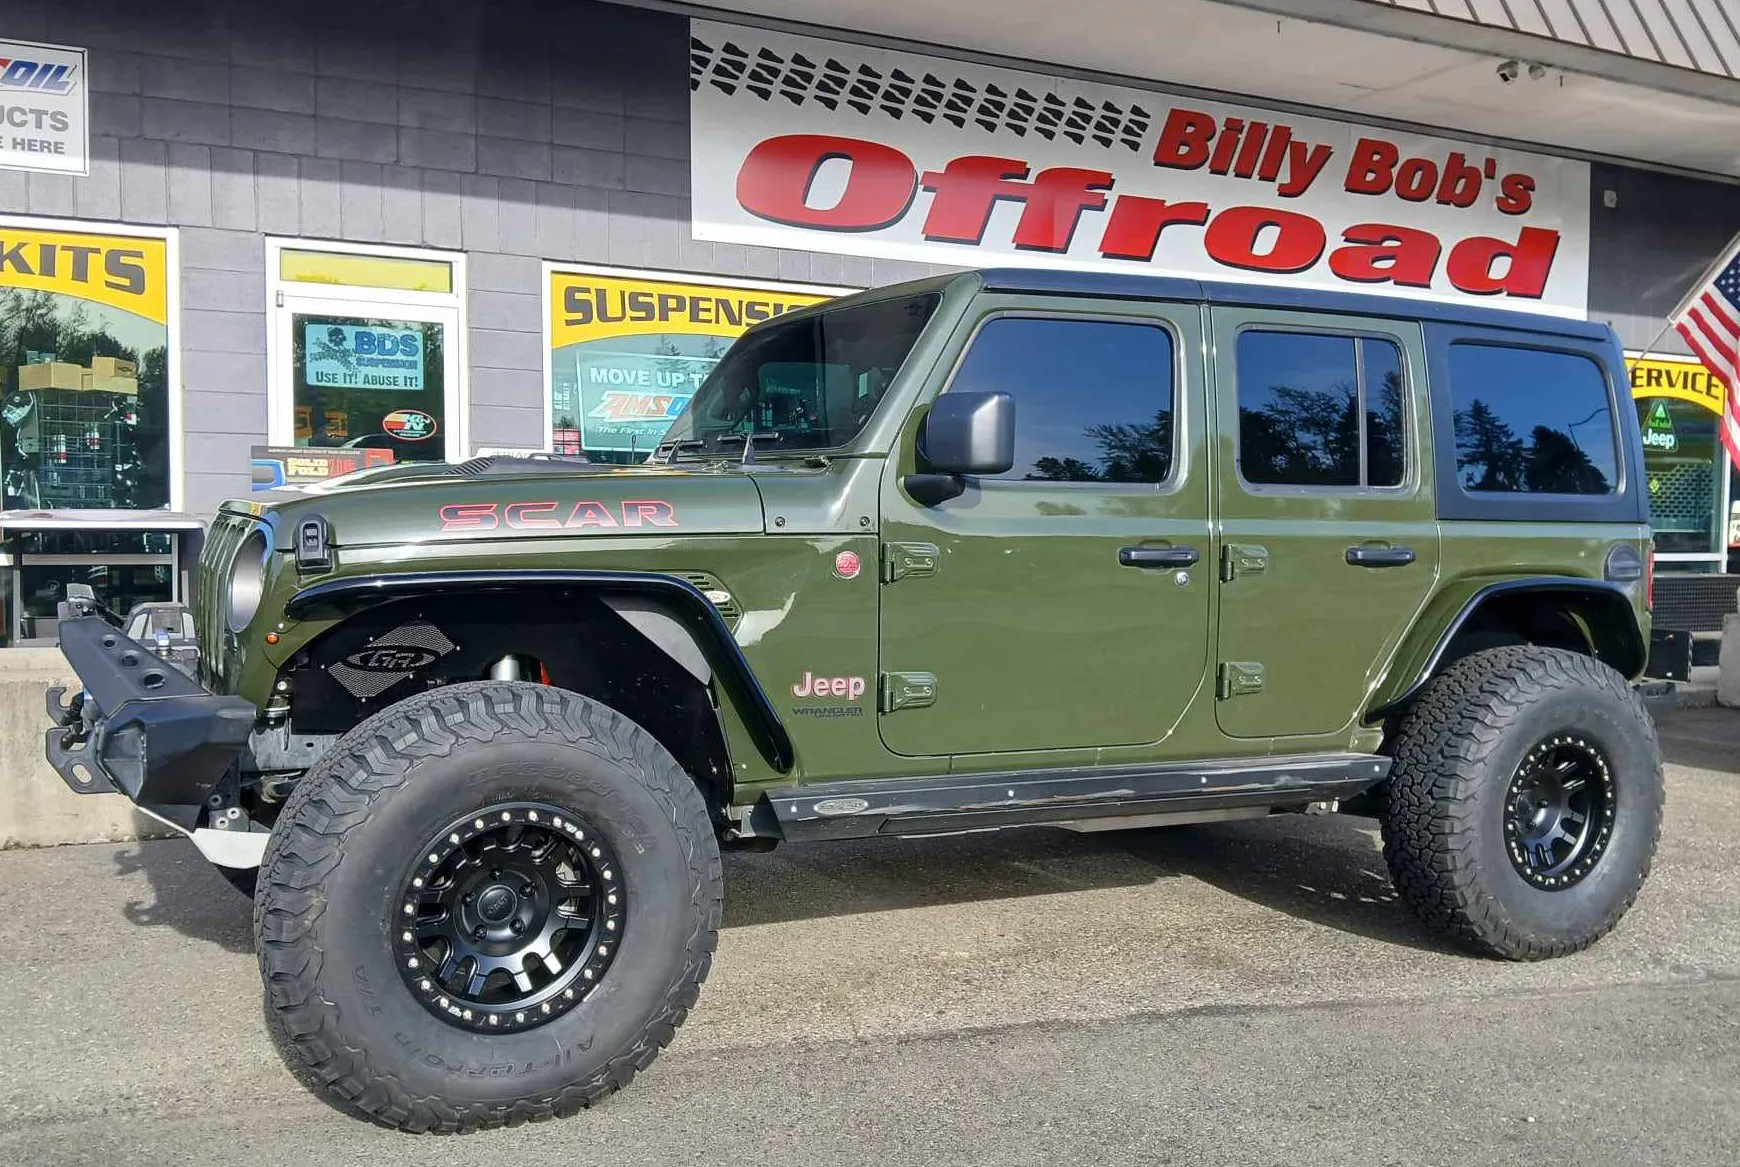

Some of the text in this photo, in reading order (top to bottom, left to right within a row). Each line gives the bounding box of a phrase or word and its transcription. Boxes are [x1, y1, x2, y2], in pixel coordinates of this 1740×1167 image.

[12, 137, 66, 154] HERE
[1153, 108, 1536, 215] Billy Bob's
[736, 134, 1560, 299] Offroad
[0, 240, 145, 295] KITS
[564, 286, 807, 327] SUSPENS
[355, 331, 419, 357] BDS
[315, 371, 418, 388] USE IT! ABUSE IT!
[589, 367, 709, 388] MOVE UP T
[597, 426, 617, 435] The
[620, 427, 645, 436] First
[1643, 428, 1675, 449] Jeep
[440, 500, 679, 532] SCAR
[792, 671, 866, 701] Jeep
